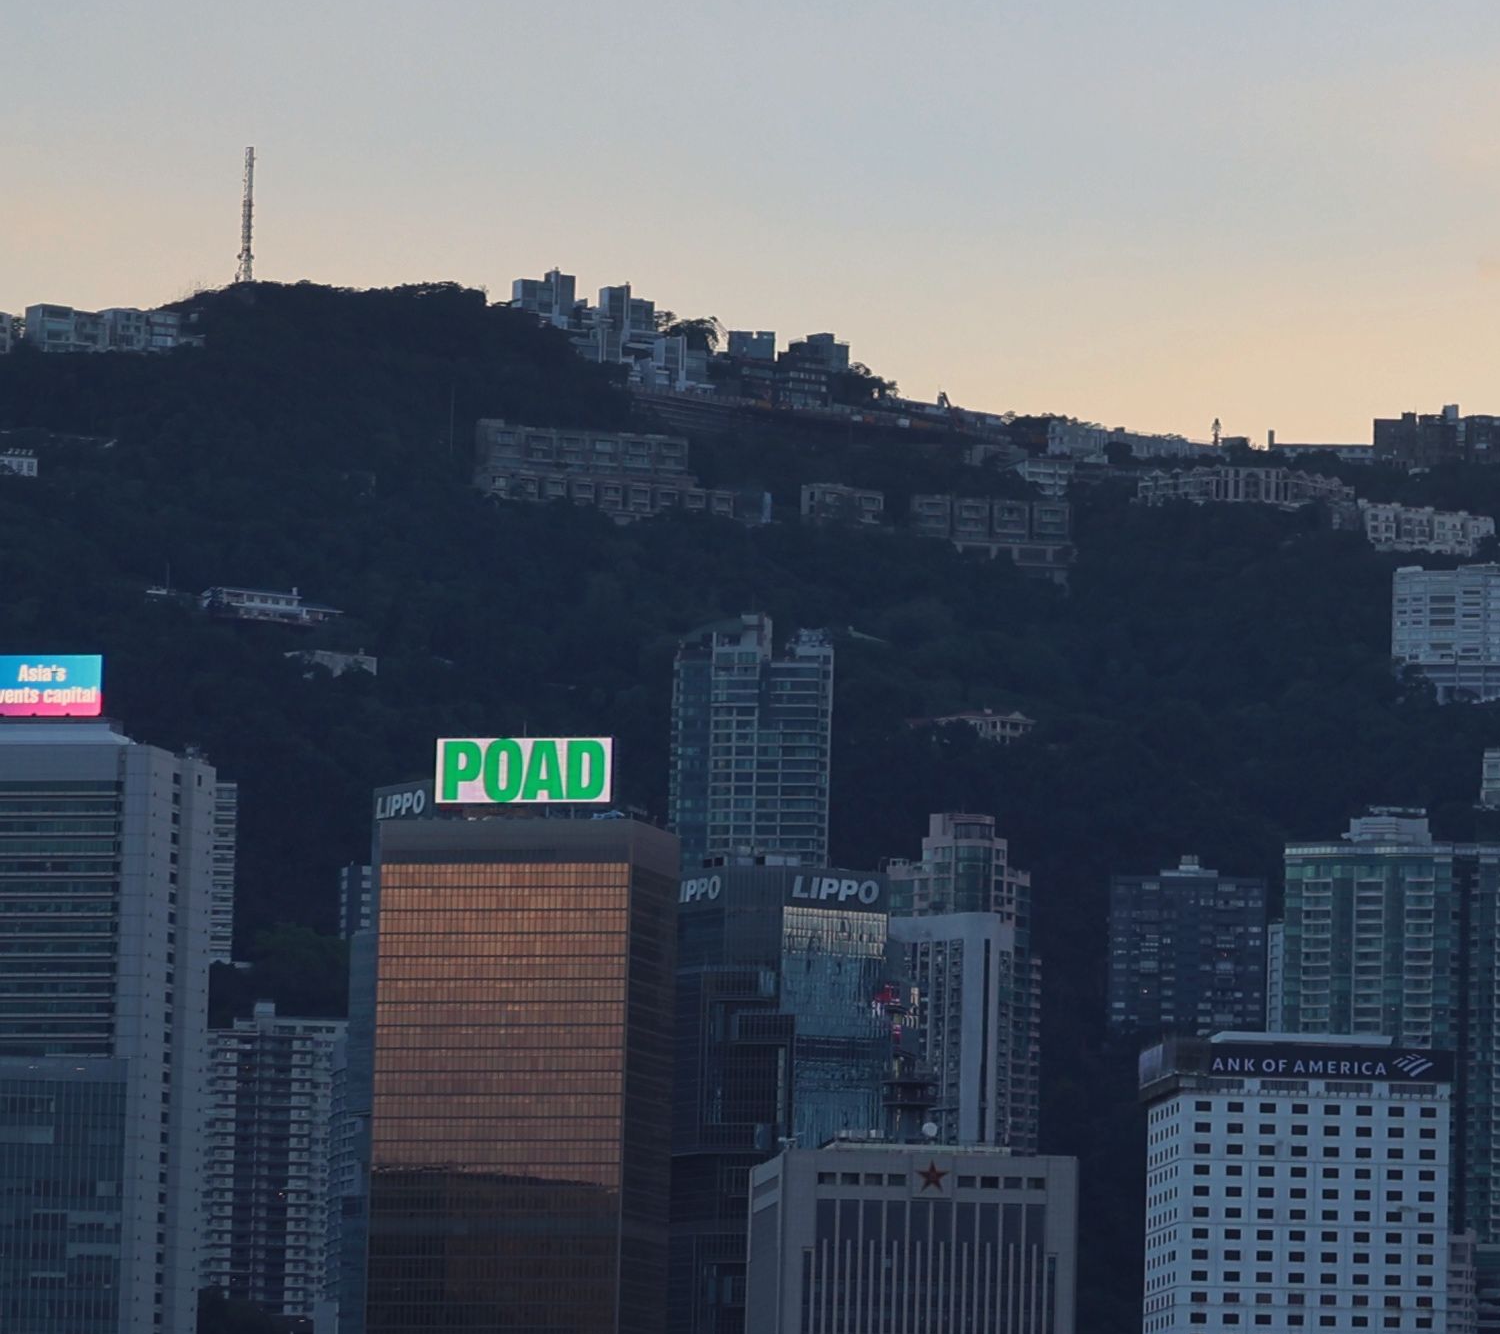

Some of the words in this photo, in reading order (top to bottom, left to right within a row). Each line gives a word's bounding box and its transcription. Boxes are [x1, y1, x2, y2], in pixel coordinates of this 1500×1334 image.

[17, 663, 67, 682] Asia's
[42, 686, 97, 706] capital
[442, 738, 605, 803] POAD
[376, 789, 426, 820] LIPPO
[679, 875, 722, 904] IPPO
[792, 875, 880, 905] LIPPO
[1212, 1057, 1256, 1072] ANK
[1262, 1058, 1289, 1072] OF
[1293, 1059, 1388, 1076] AMERICA
